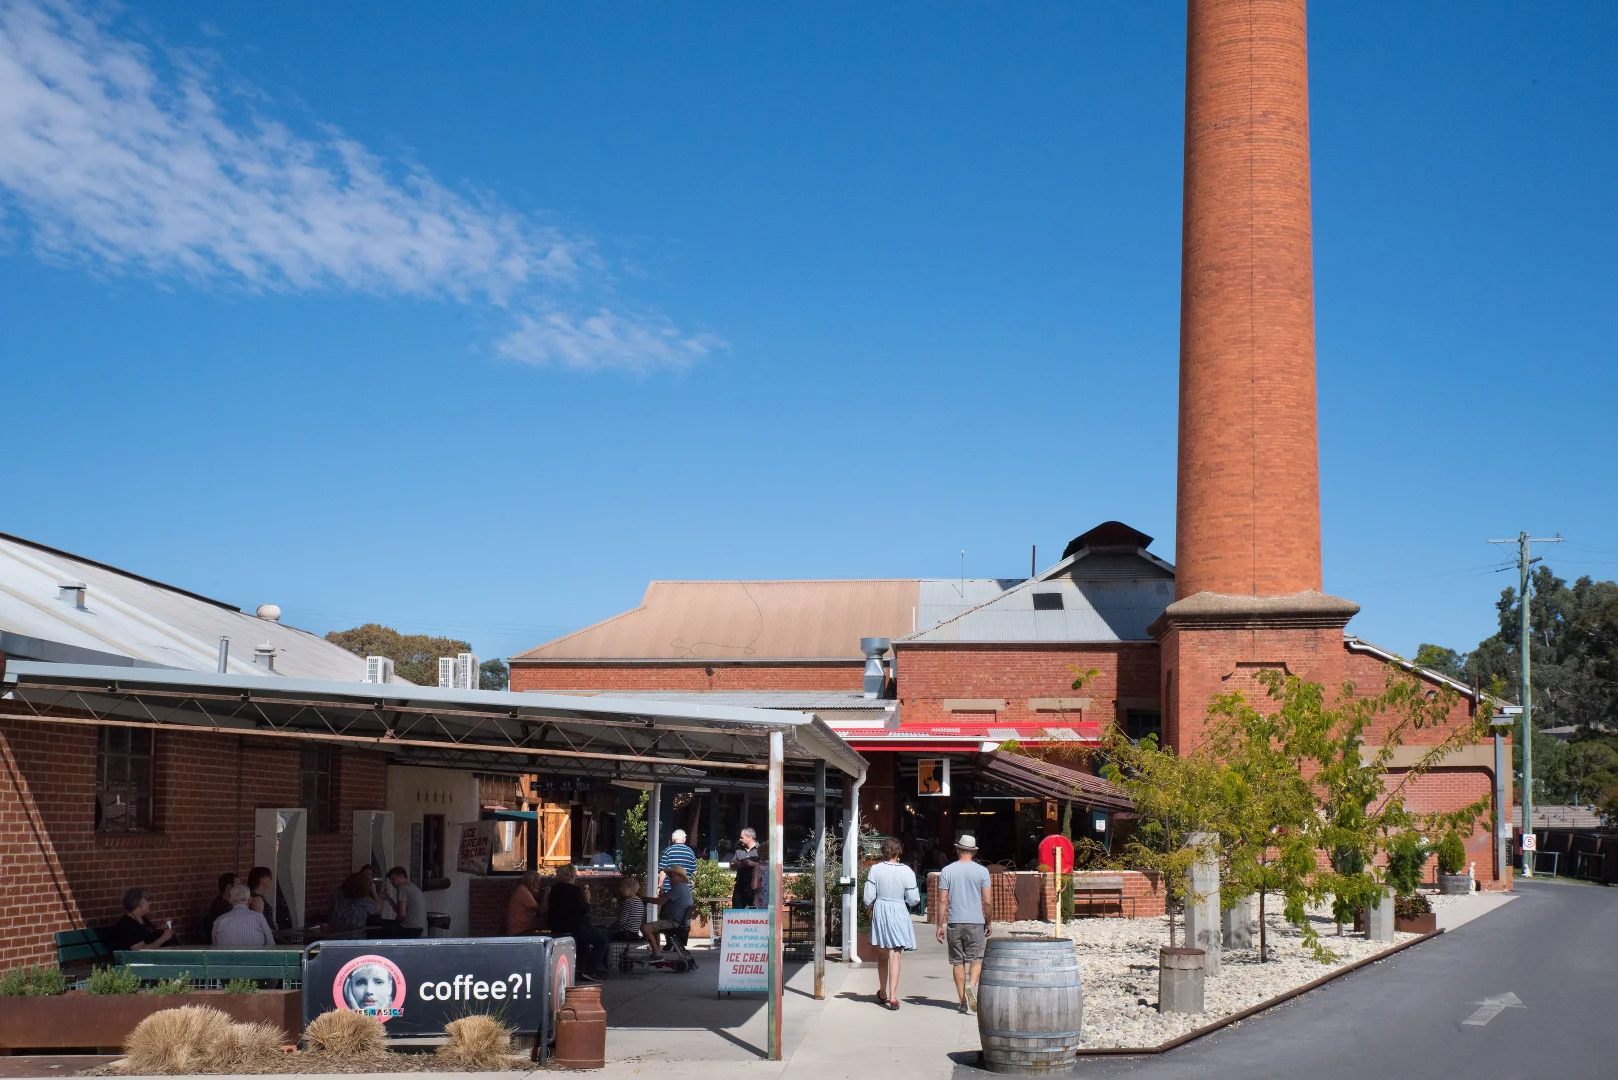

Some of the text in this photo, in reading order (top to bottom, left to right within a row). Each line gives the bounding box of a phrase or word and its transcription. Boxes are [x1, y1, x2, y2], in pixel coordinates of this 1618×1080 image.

[464, 828, 477, 838] ICE
[462, 836, 488, 848] CREAM
[460, 846, 487, 858] SOCIAL
[726, 953, 768, 962] ICE CREA
[732, 964, 764, 974] SOCIAL
[419, 973, 532, 1000] coffee?!
